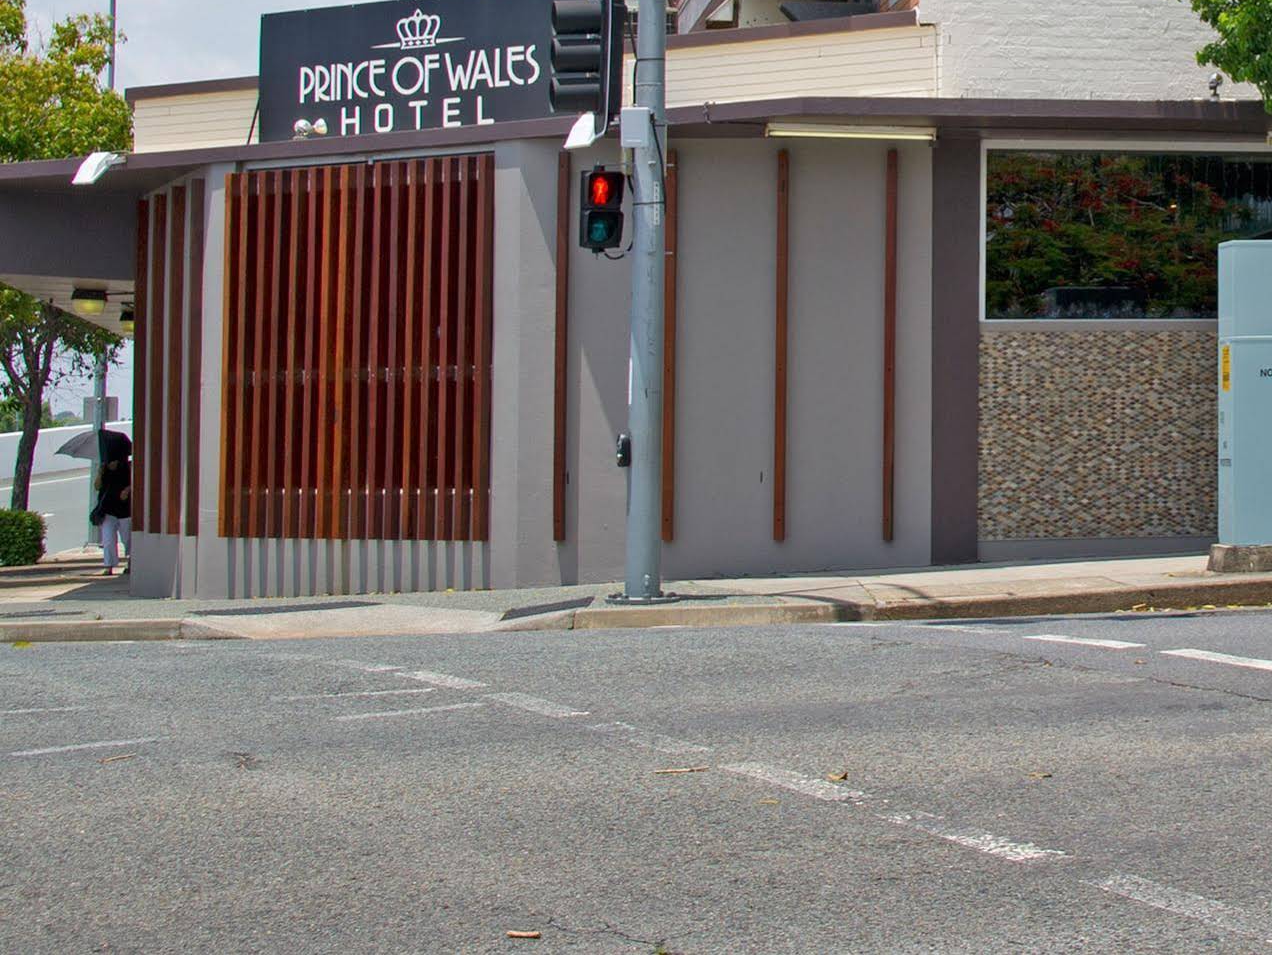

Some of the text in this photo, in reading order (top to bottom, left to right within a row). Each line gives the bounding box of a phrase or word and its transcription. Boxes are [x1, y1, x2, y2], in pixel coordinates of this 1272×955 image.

[299, 44, 541, 104] PRINCE OF WALES
[340, 95, 495, 137] HOTEL
